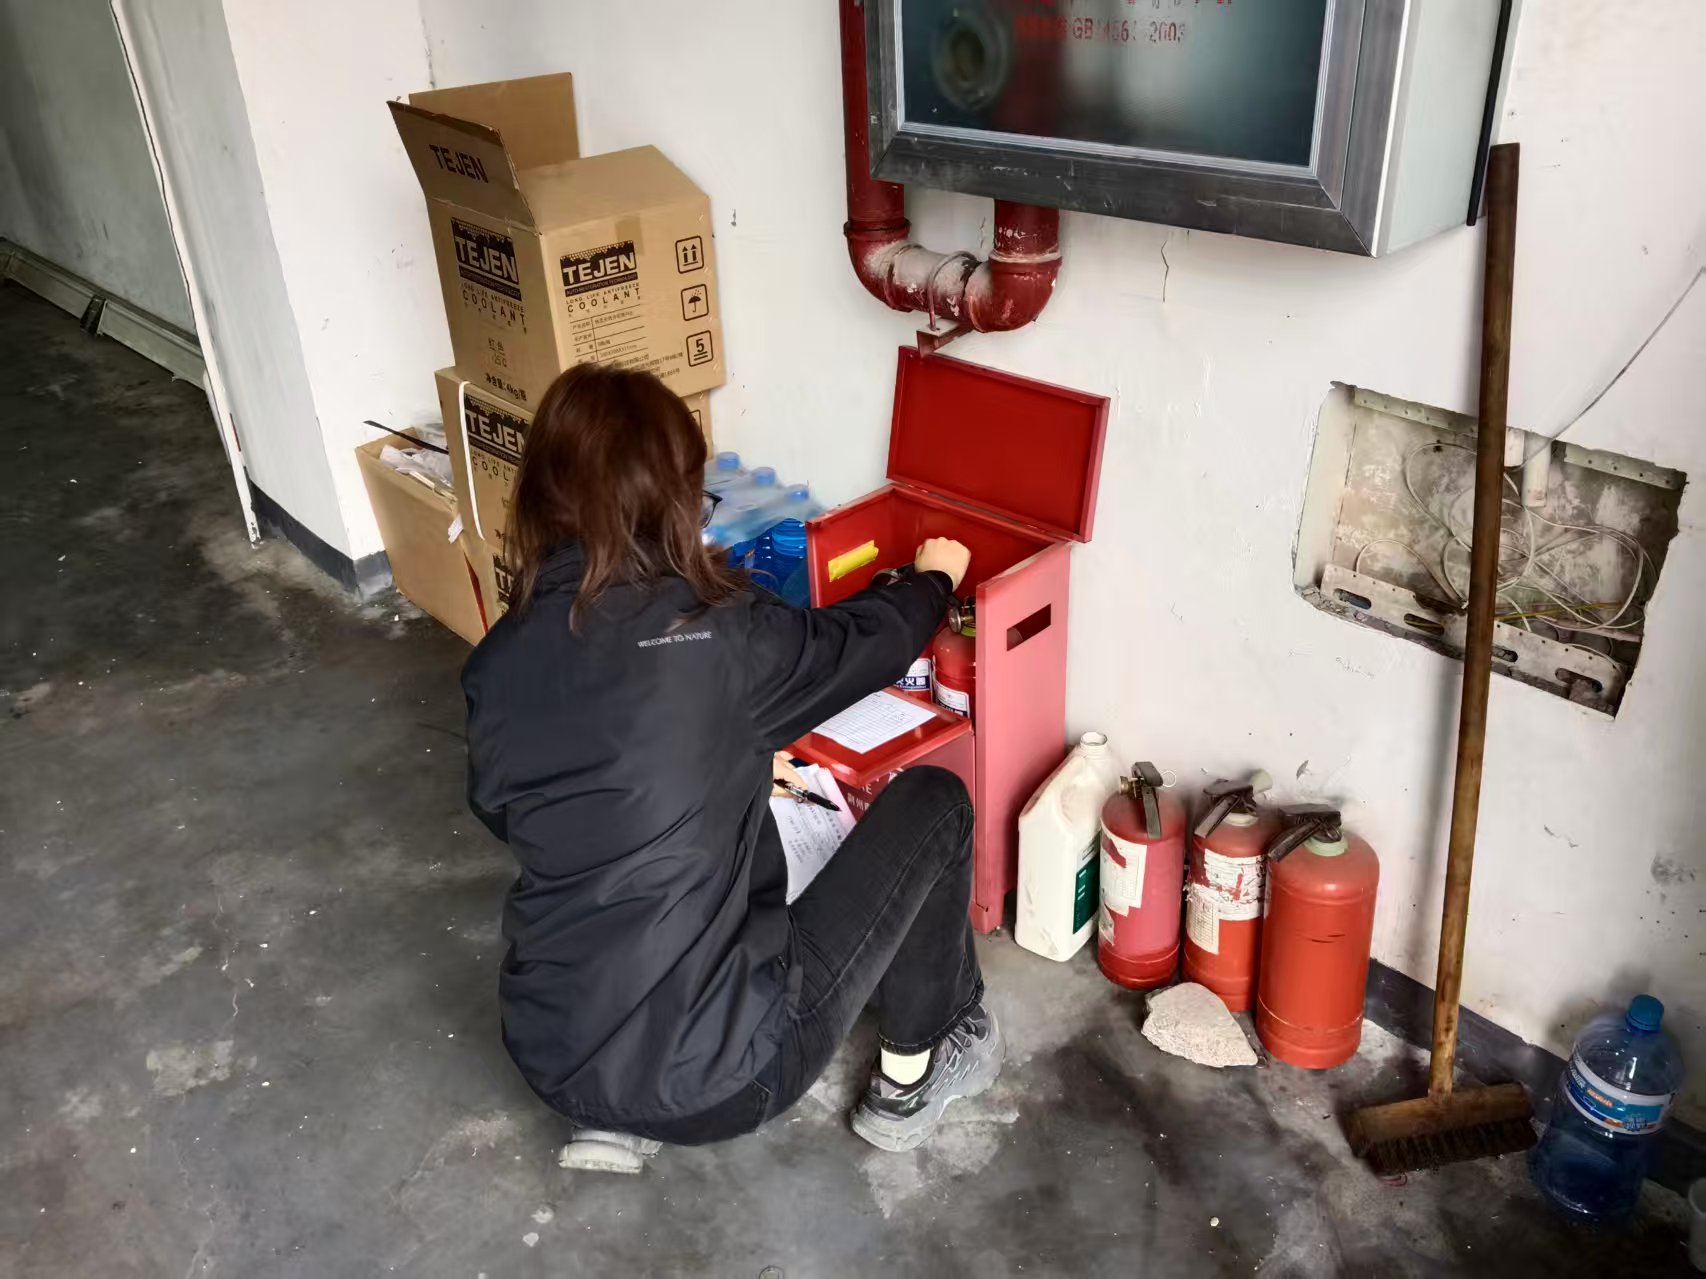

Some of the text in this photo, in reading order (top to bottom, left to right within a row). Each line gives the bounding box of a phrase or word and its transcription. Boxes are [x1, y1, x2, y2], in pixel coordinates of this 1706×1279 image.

[1072, 17, 1093, 39] GB
[429, 144, 489, 183] TEJEN
[454, 235, 518, 283] TEJEN
[563, 252, 636, 285] TEJEN
[462, 289, 526, 326] COOLANT
[567, 287, 640, 313] COOLANT
[695, 338, 705, 353] 5
[472, 456, 509, 481] COOL
[637, 630, 713, 648] WELCOME TO NATURE
